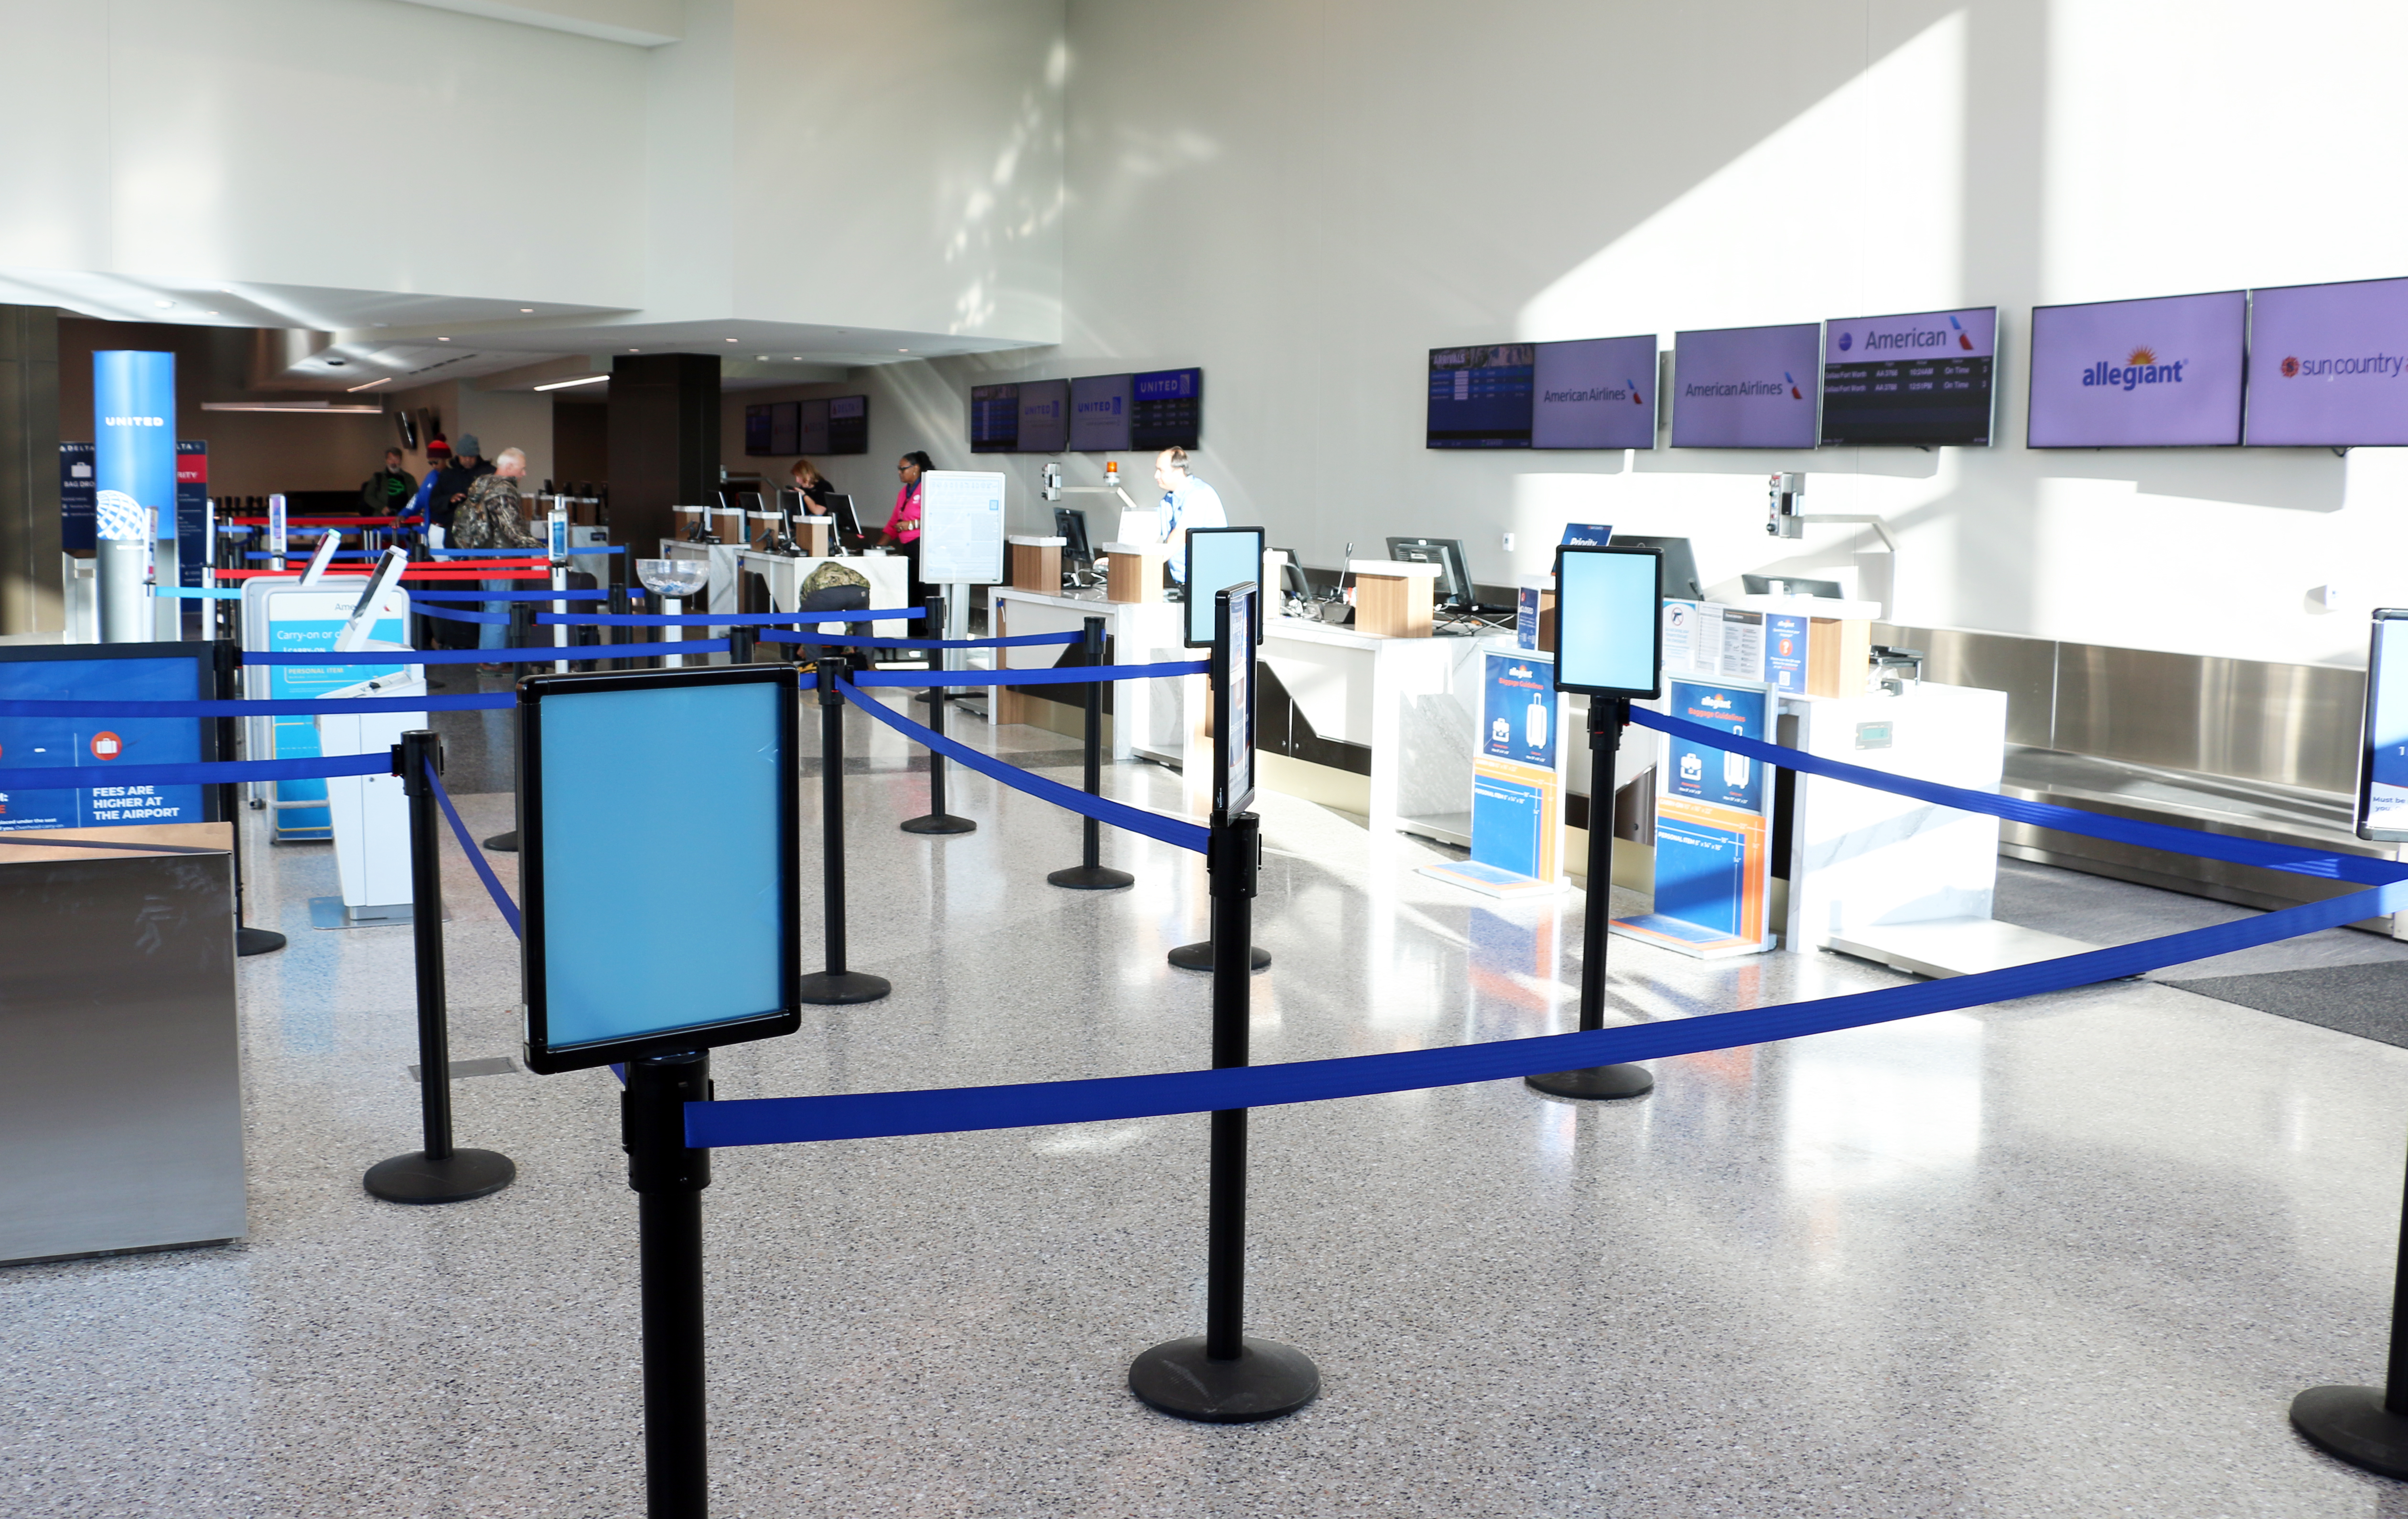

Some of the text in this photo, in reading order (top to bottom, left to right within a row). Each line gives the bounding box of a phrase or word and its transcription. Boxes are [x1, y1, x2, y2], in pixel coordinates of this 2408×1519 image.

[1865, 328, 1946, 350] American
[2302, 359, 2332, 375] sun
[2335, 353, 2404, 378] country
[2082, 361, 2183, 391] allegiant
[1140, 380, 1177, 393] UNITED
[1685, 381, 1783, 396] American Airlines
[1544, 387, 1626, 402] American Airlines
[1024, 405, 1051, 415] UNITED
[1078, 401, 1110, 412] UNITED
[105, 417, 164, 427] UNITED
[1570, 537, 1598, 546] Priority
[277, 630, 320, 642] Carry-on
[1509, 667, 1533, 679] allegiant
[1498, 677, 1544, 690] Baggage Guidelines
[1701, 696, 1732, 709] allegiant
[1688, 707, 1746, 722] Baggage Guidelines
[93, 785, 154, 797] FEES ARE
[93, 796, 163, 809] HIGHER AT
[1659, 798, 1684, 808] CARRY-ON
[93, 807, 180, 821] THE AIRPORT
[1658, 831, 1683, 843] PERSONAL
